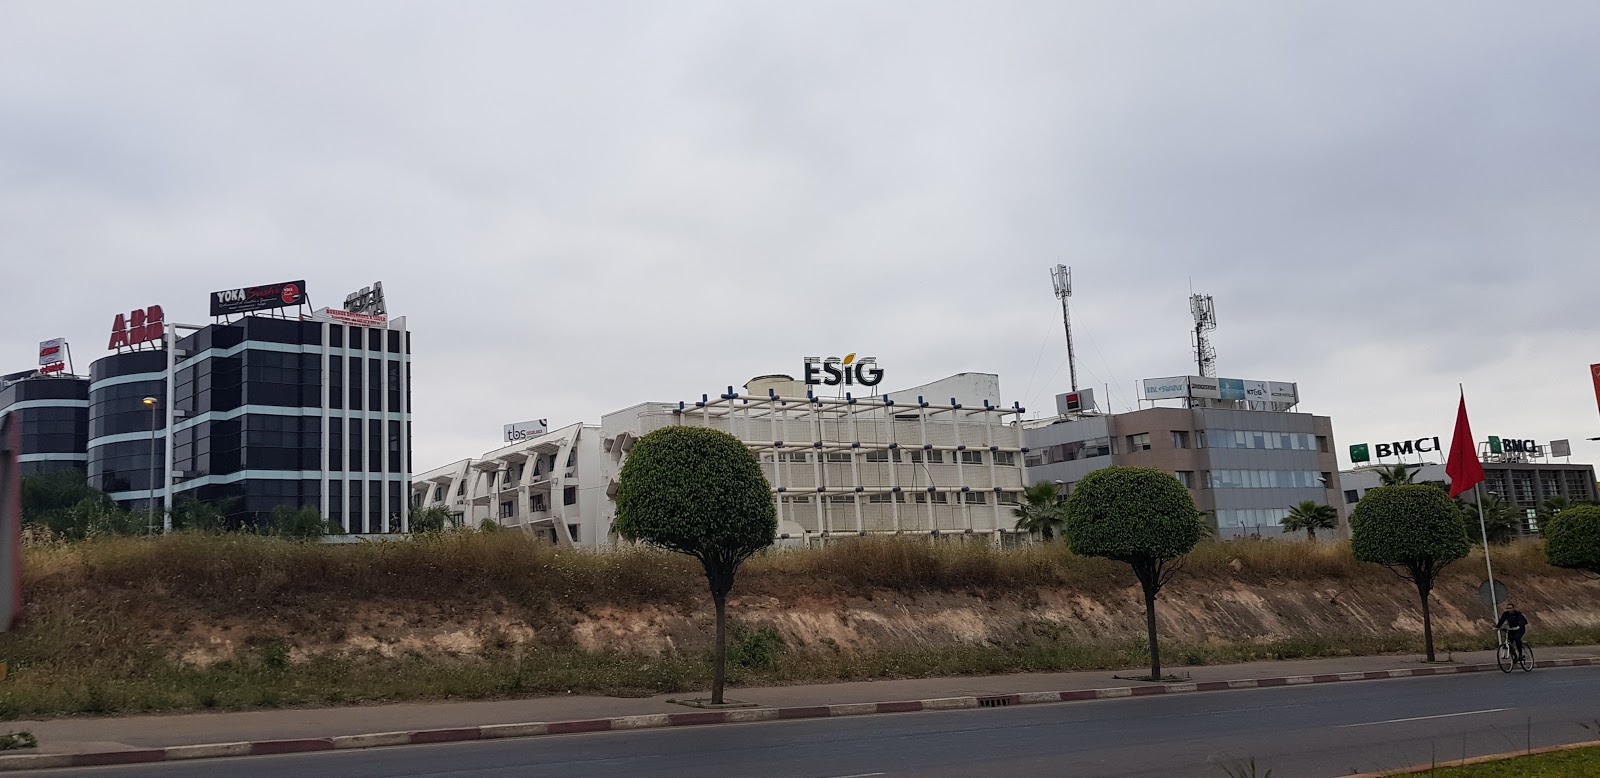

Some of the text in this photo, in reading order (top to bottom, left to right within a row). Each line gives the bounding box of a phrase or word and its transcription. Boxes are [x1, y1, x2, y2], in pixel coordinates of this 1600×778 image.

[217, 288, 246, 303] YOKA
[108, 305, 164, 350] ABB
[508, 425, 526, 441] tbs
[1375, 436, 1440, 458] BMCI
[1502, 438, 1536, 453] BMCI
